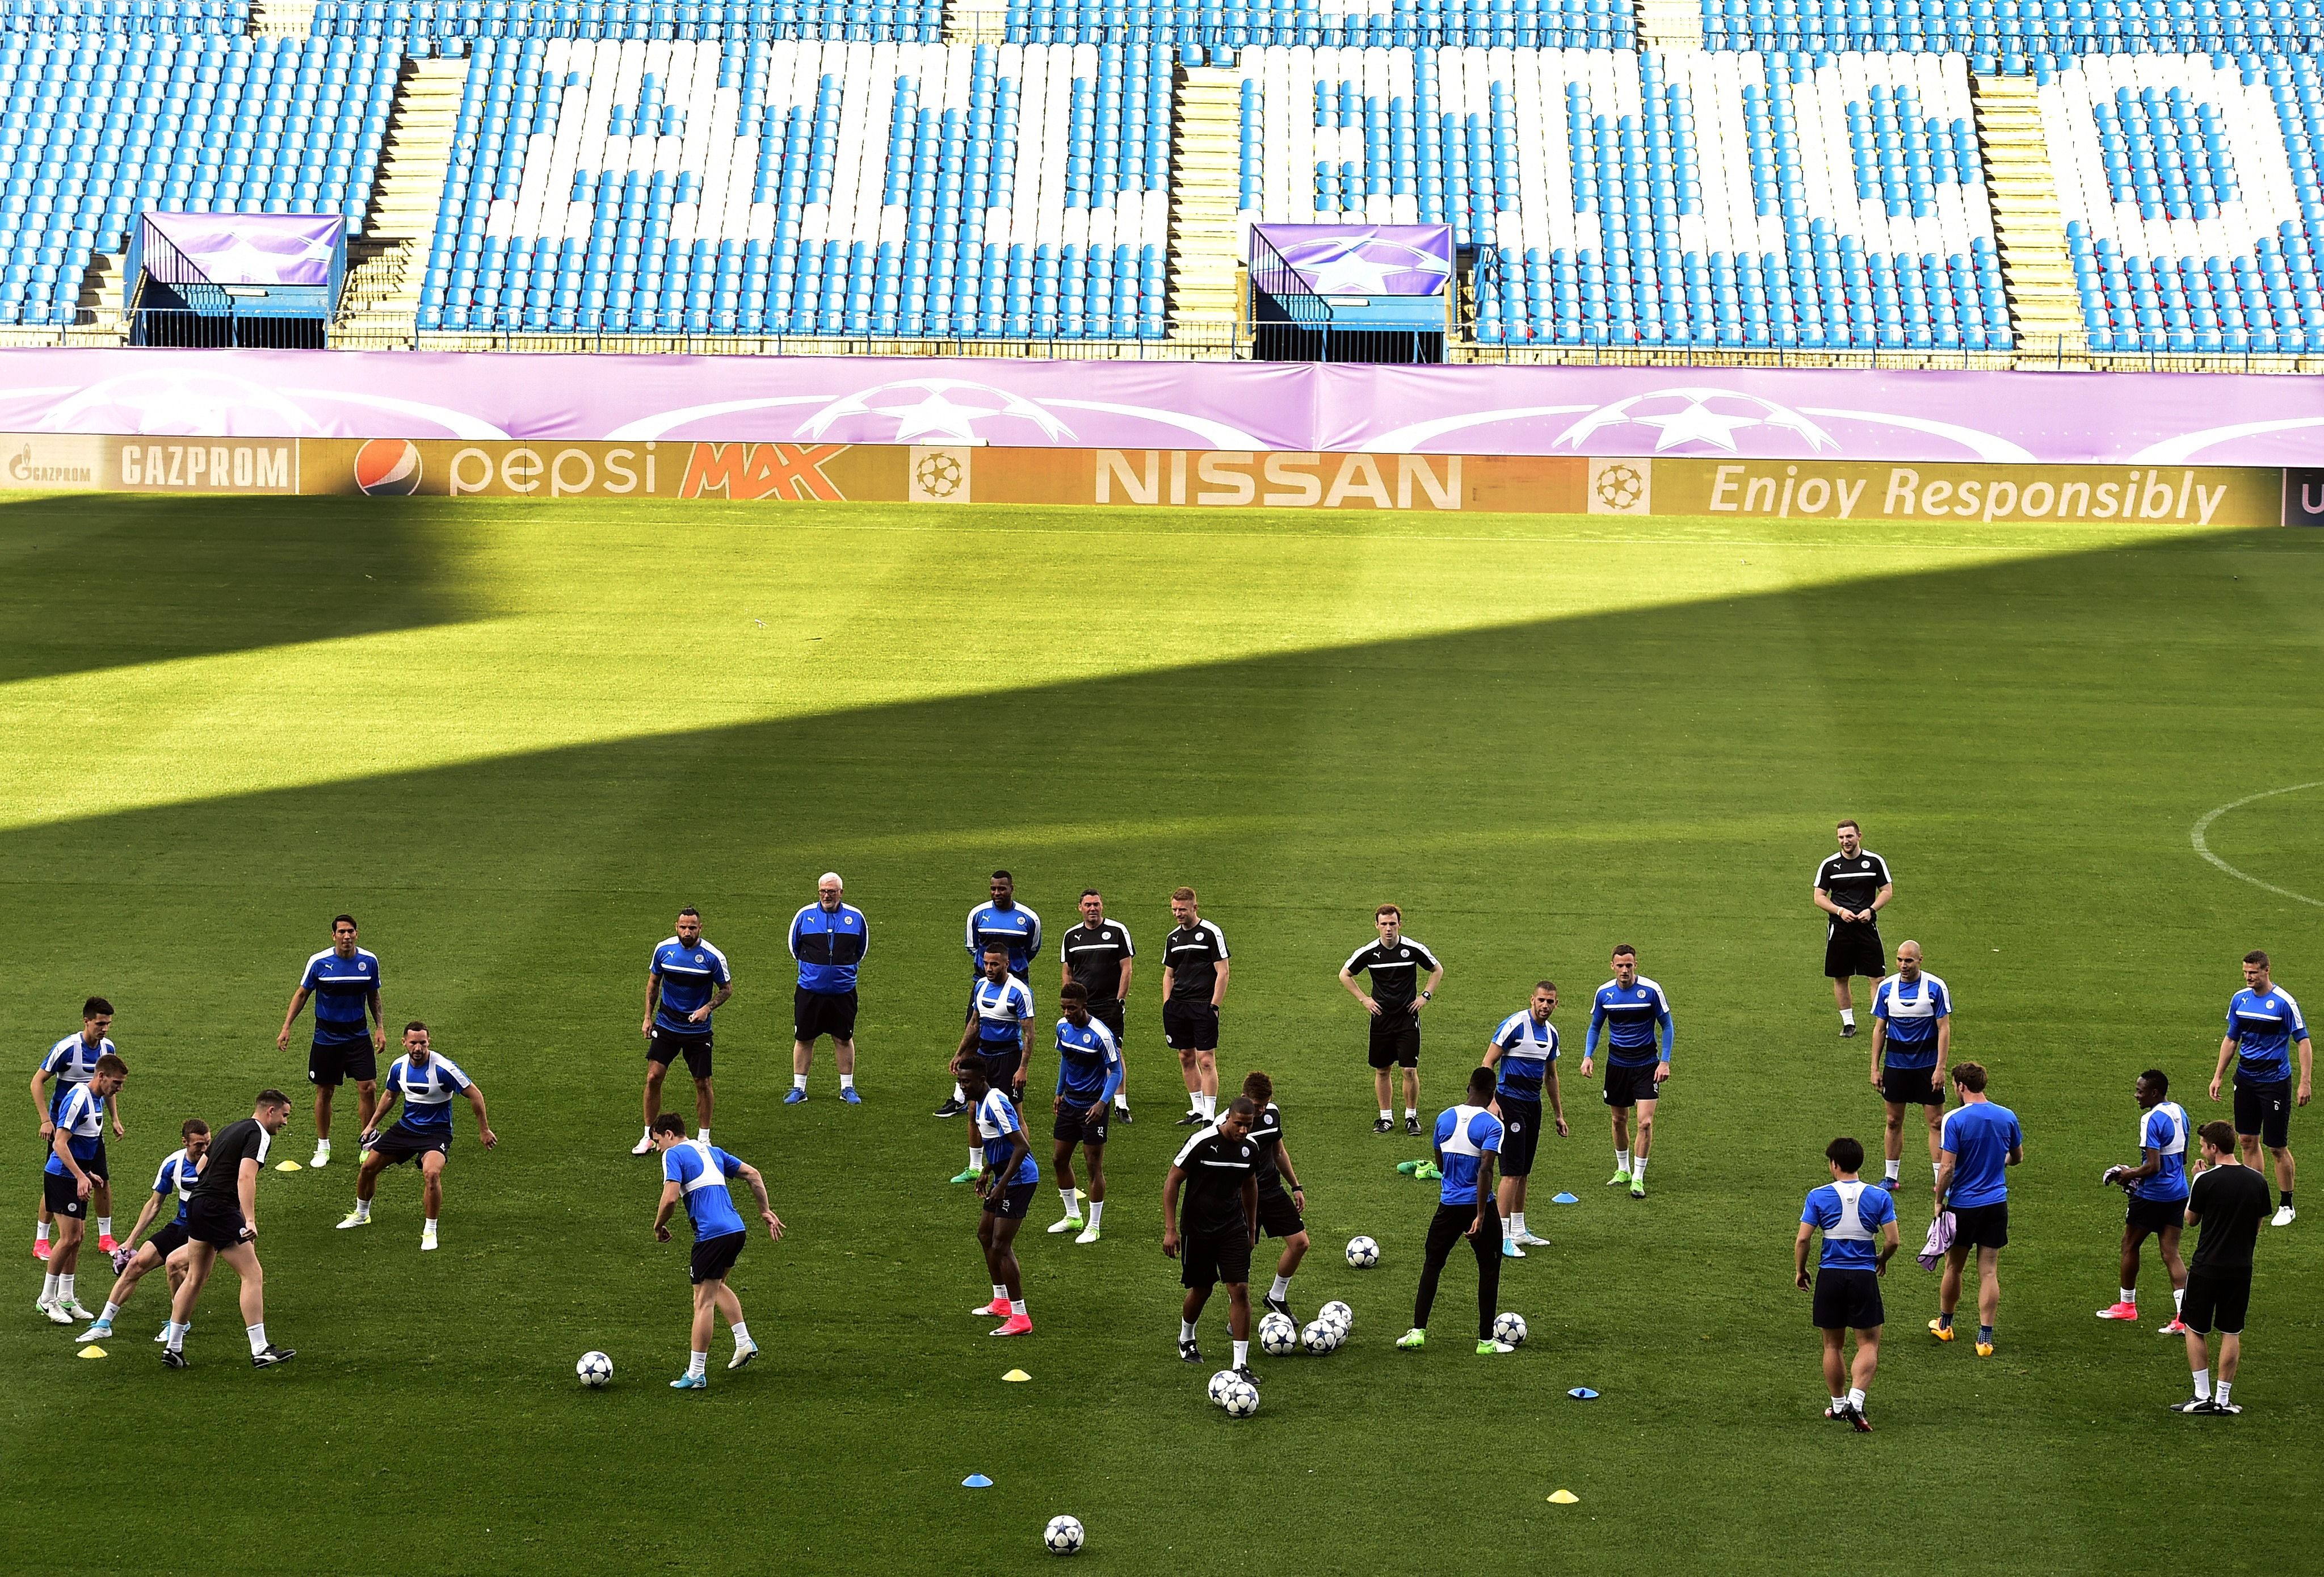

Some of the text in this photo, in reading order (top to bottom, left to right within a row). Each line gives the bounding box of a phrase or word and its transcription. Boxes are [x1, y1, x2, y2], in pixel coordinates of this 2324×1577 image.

[33, 467, 91, 483] GAZPROM
[121, 445, 288, 488] GAZPROM
[449, 441, 854, 502] pepsi MAX
[1095, 450, 1462, 510] NISSAN
[1709, 465, 2228, 526] Enjoy Responsibly
